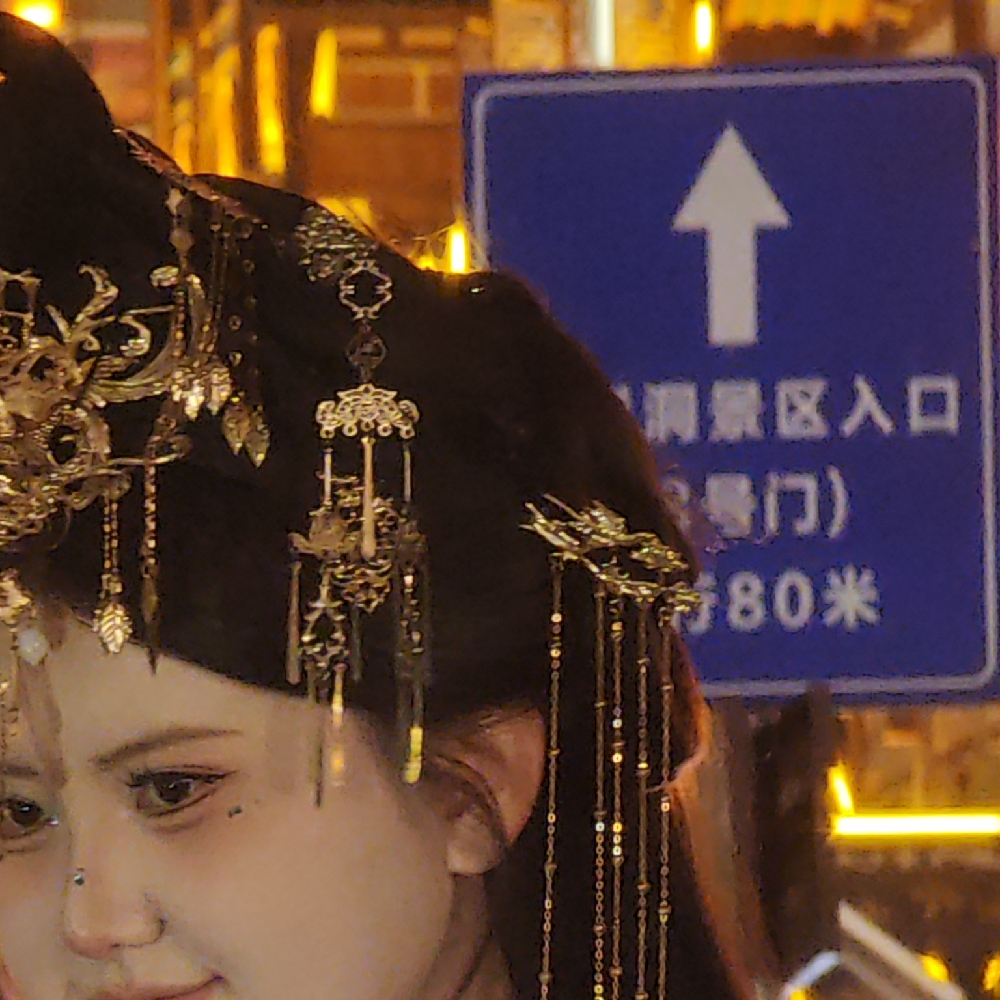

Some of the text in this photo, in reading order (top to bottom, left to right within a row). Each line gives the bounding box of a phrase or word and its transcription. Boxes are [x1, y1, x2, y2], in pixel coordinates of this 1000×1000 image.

[613, 375, 961, 442] 洞景区入口
